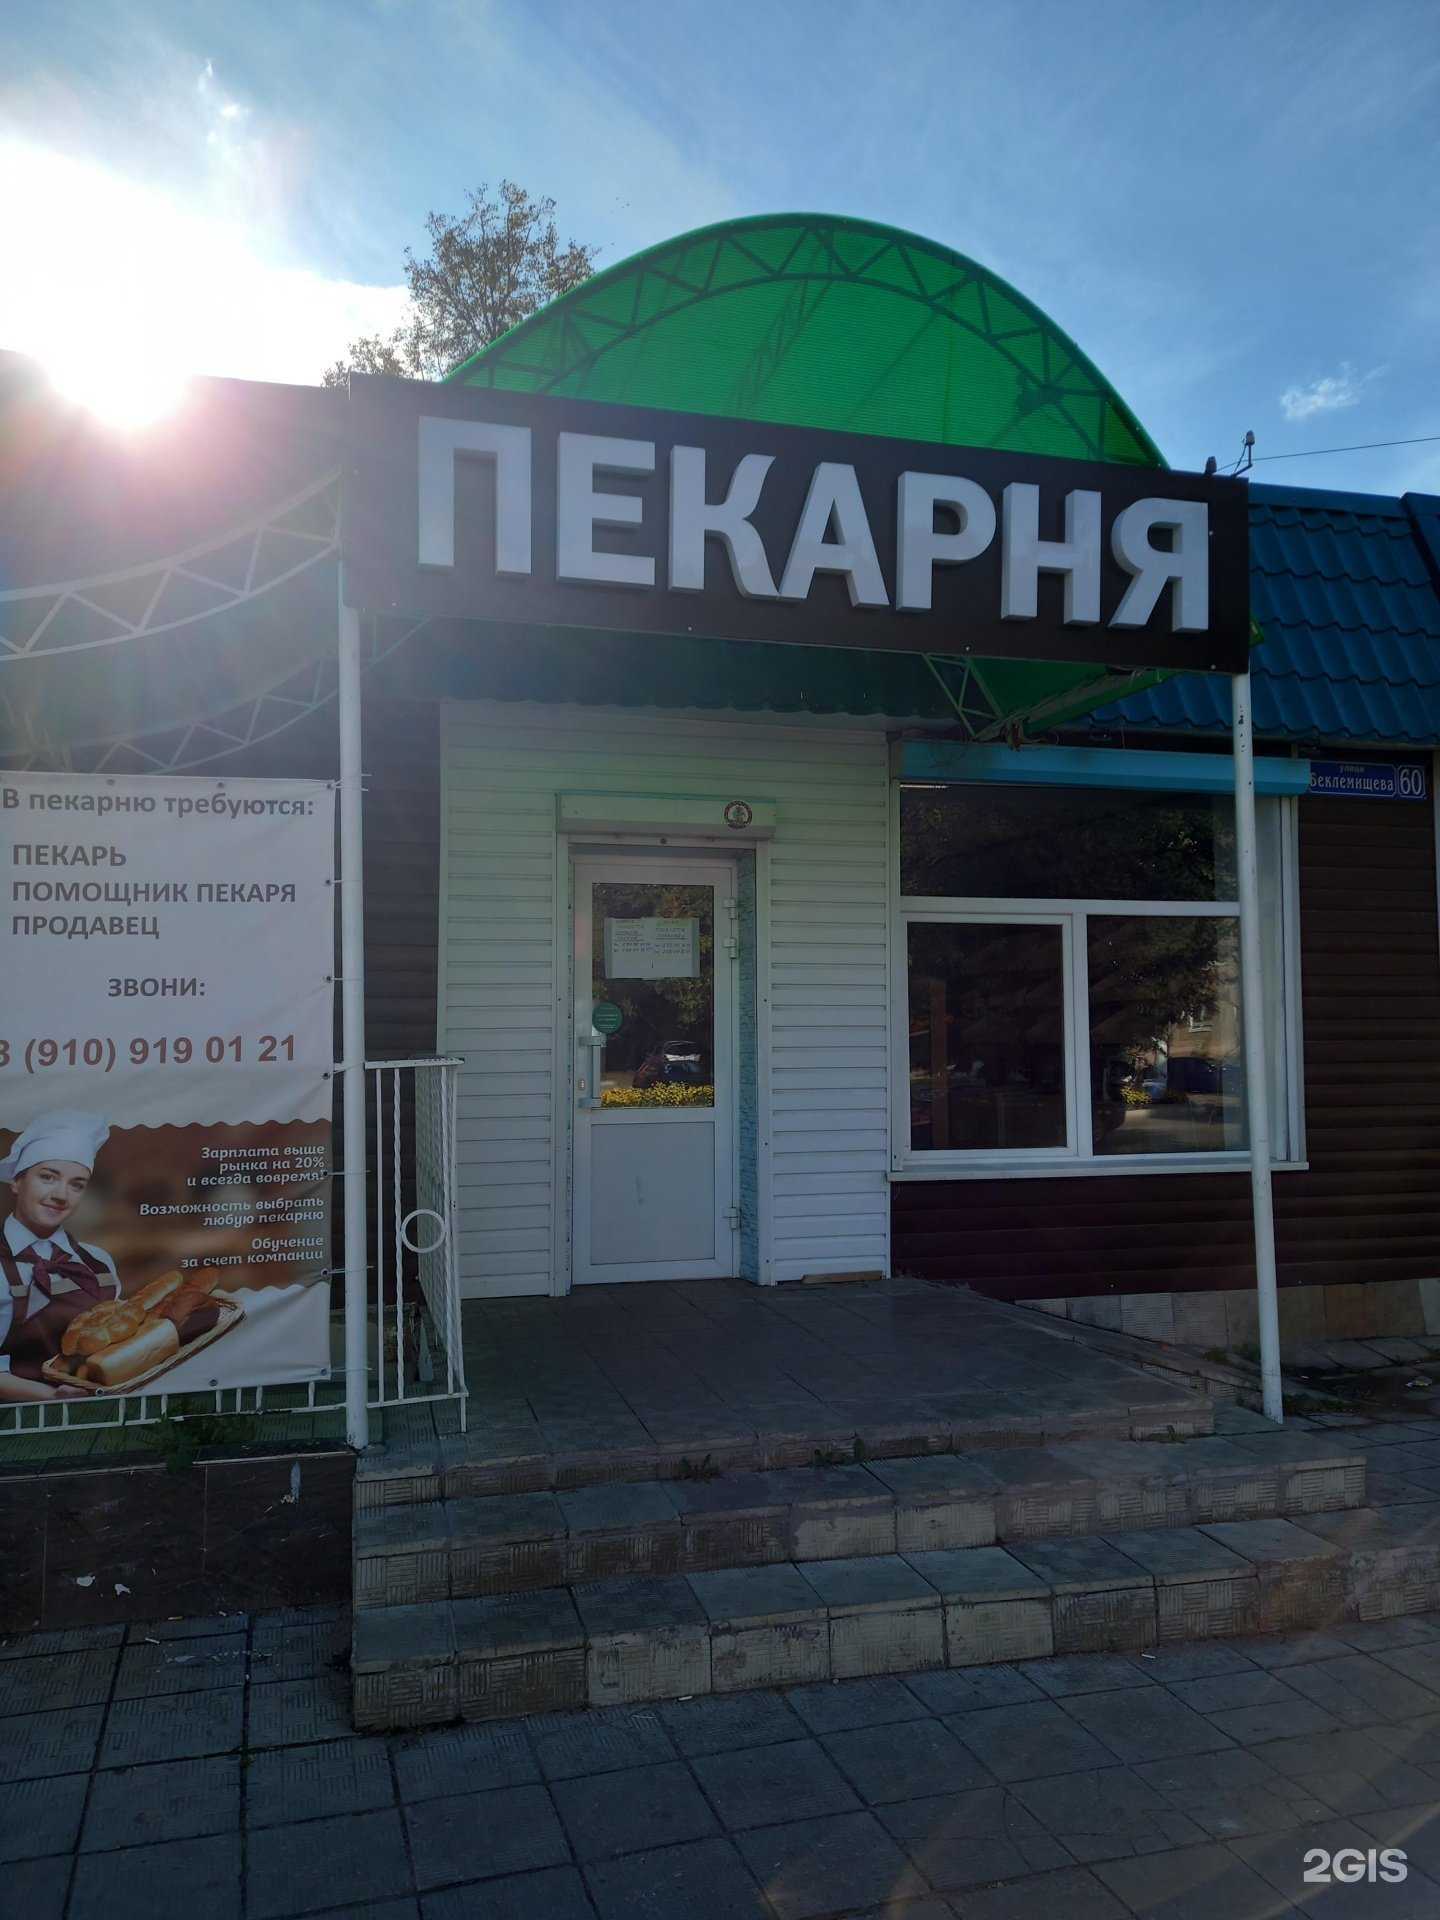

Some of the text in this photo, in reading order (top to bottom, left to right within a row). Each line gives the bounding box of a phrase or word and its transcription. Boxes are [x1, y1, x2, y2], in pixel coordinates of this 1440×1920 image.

[417, 415, 1209, 633] ПЕКАРНЯ
[1400, 768, 1422, 795] 60
[2, 788, 315, 819] В пекарню требуются:
[12, 844, 127, 867] ПЕКАРЬ
[12, 881, 296, 906] ПОМОЩНИК ПЕКАРЯ
[12, 915, 160, 940] ПРОДАВЕЦ
[108, 977, 206, 997] ЗВОНИ:
[24, 1037, 116, 1074] (910)
[129, 1036, 193, 1065] 919
[205, 1034, 243, 1063] 01
[258, 1034, 295, 1062] 21
[201, 1145, 325, 1160] Зарплата выше
[219, 1156, 325, 1174] рынка на 20%
[187, 1176, 197, 1187] и
[201, 1173, 251, 1187] всегда
[139, 1196, 324, 1216] Возможность выбрать
[203, 1210, 324, 1228] любую пекарню
[251, 1236, 324, 1252] Обучение
[181, 1249, 324, 1269] за счет компании
